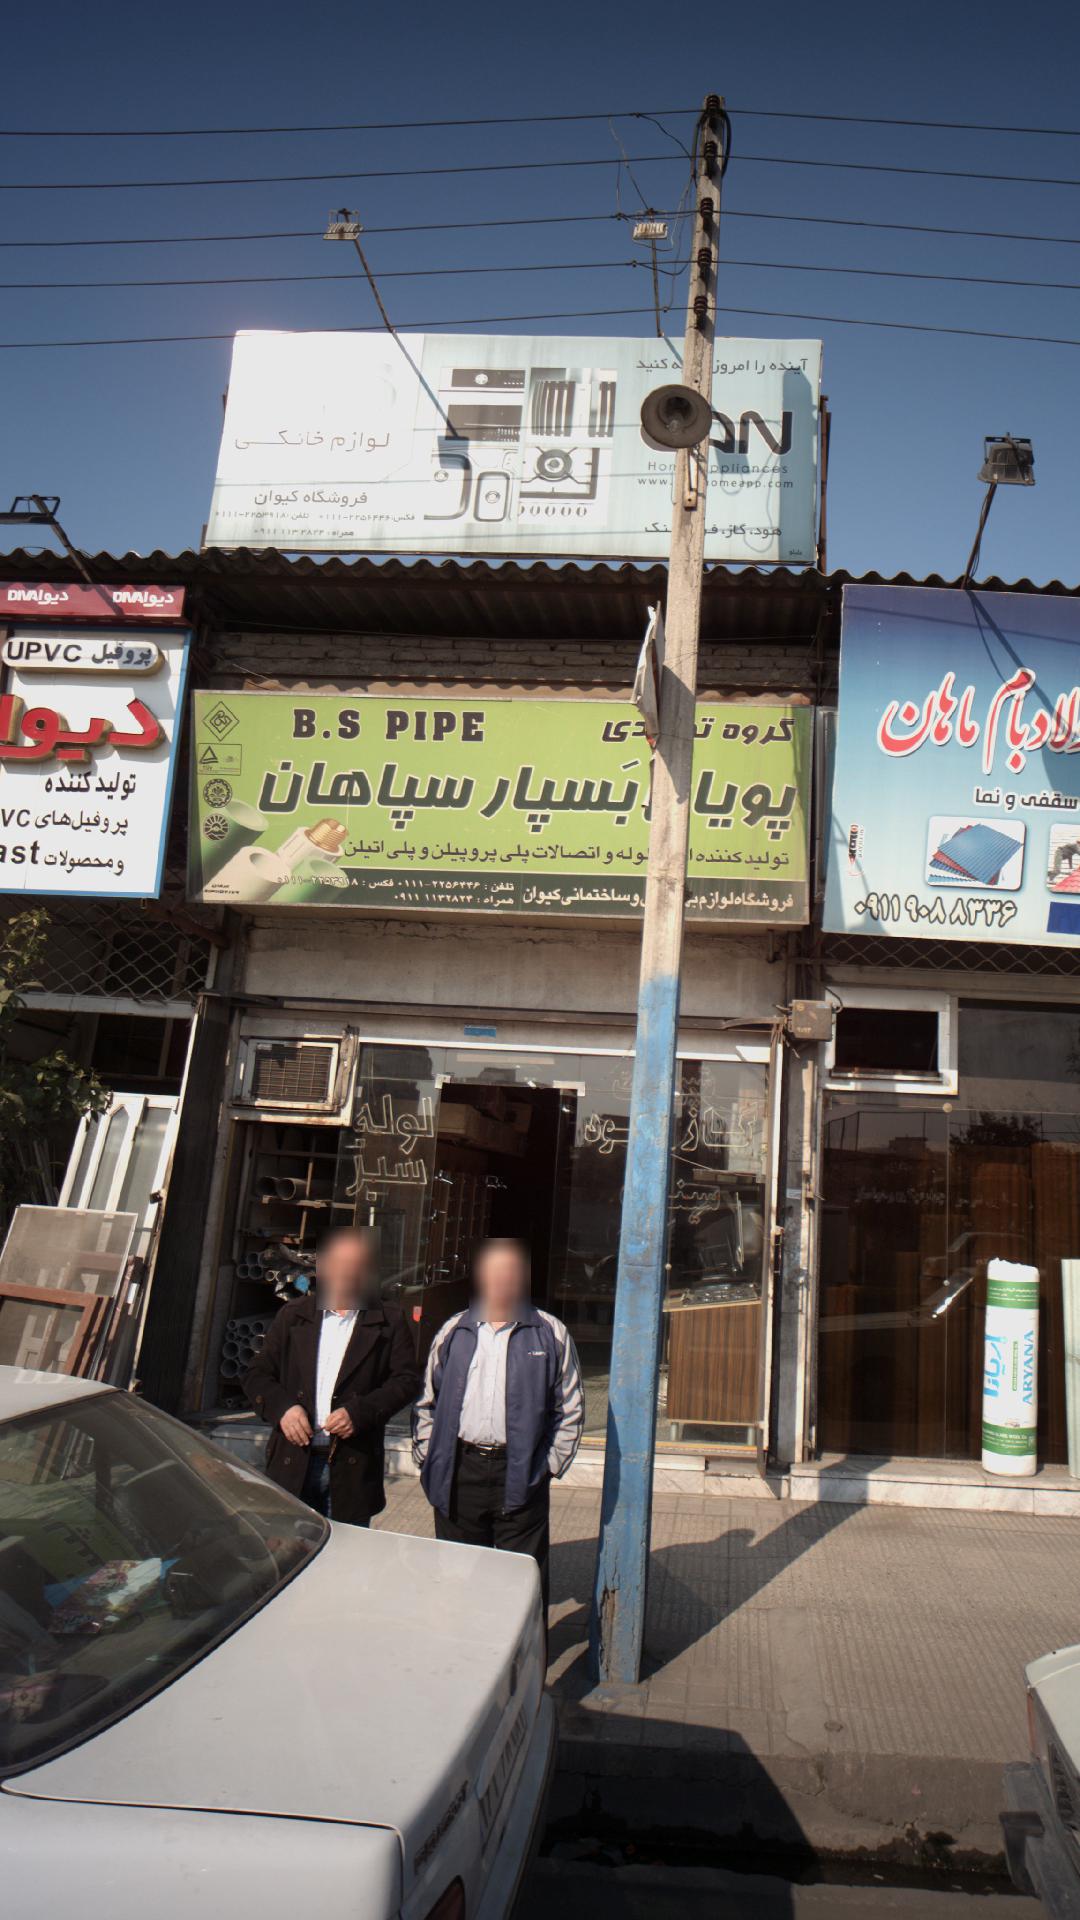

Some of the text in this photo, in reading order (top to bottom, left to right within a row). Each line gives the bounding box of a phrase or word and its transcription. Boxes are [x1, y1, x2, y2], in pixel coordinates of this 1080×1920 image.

[755, 360, 765, 374] را
[769, 358, 808, 375] آینده
[330, 432, 390, 452] لوازم
[710, 463, 788, 475] ppliances
[254, 490, 368, 508] فروشگاه کیوان
[7, 641, 82, 662] UPVC
[91, 643, 152, 666] پروفیل
[877, 672, 980, 757] ماهان
[292, 708, 485, 742] B.S PIPE
[722, 717, 796, 745] گروه
[45, 771, 136, 801] تولید کننده
[257, 760, 476, 832] سپاهان
[975, 788, 1000, 804] نما
[344, 839, 384, 858] اتیلن
[386, 841, 416, 860] پلی
[500, 844, 530, 864] پلی
[532, 844, 600, 860] اتصالات
[696, 849, 743, 863] کننده
[744, 851, 789, 870] تولید
[523, 885, 561, 905] کیوان
[734, 891, 794, 912] فروشگاه
[854, 892, 900, 921] ۰۹۱۱
[1022, 1330, 1035, 1406] ARYANA
